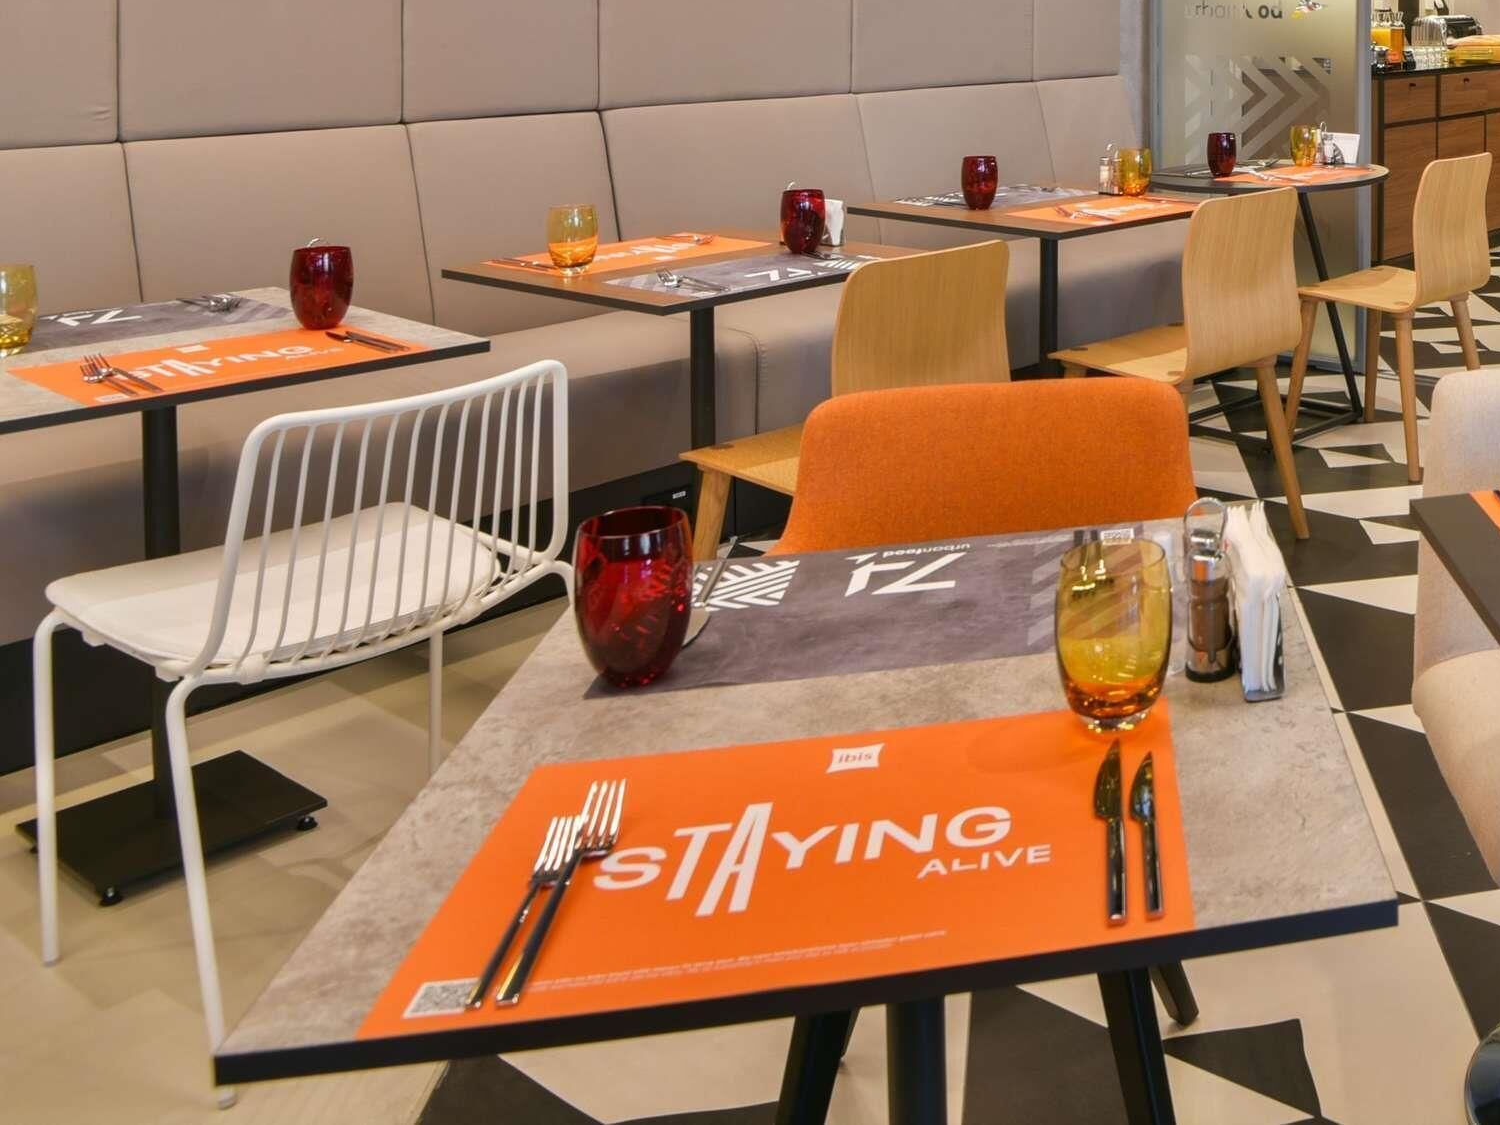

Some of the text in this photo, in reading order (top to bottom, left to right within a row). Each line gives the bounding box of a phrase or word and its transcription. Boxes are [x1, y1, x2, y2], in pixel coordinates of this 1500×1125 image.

[882, 543, 971, 559] urbanfood
[837, 749, 874, 764] ibis
[593, 801, 1013, 917] STAYING
[917, 843, 1052, 879] ALIVE
